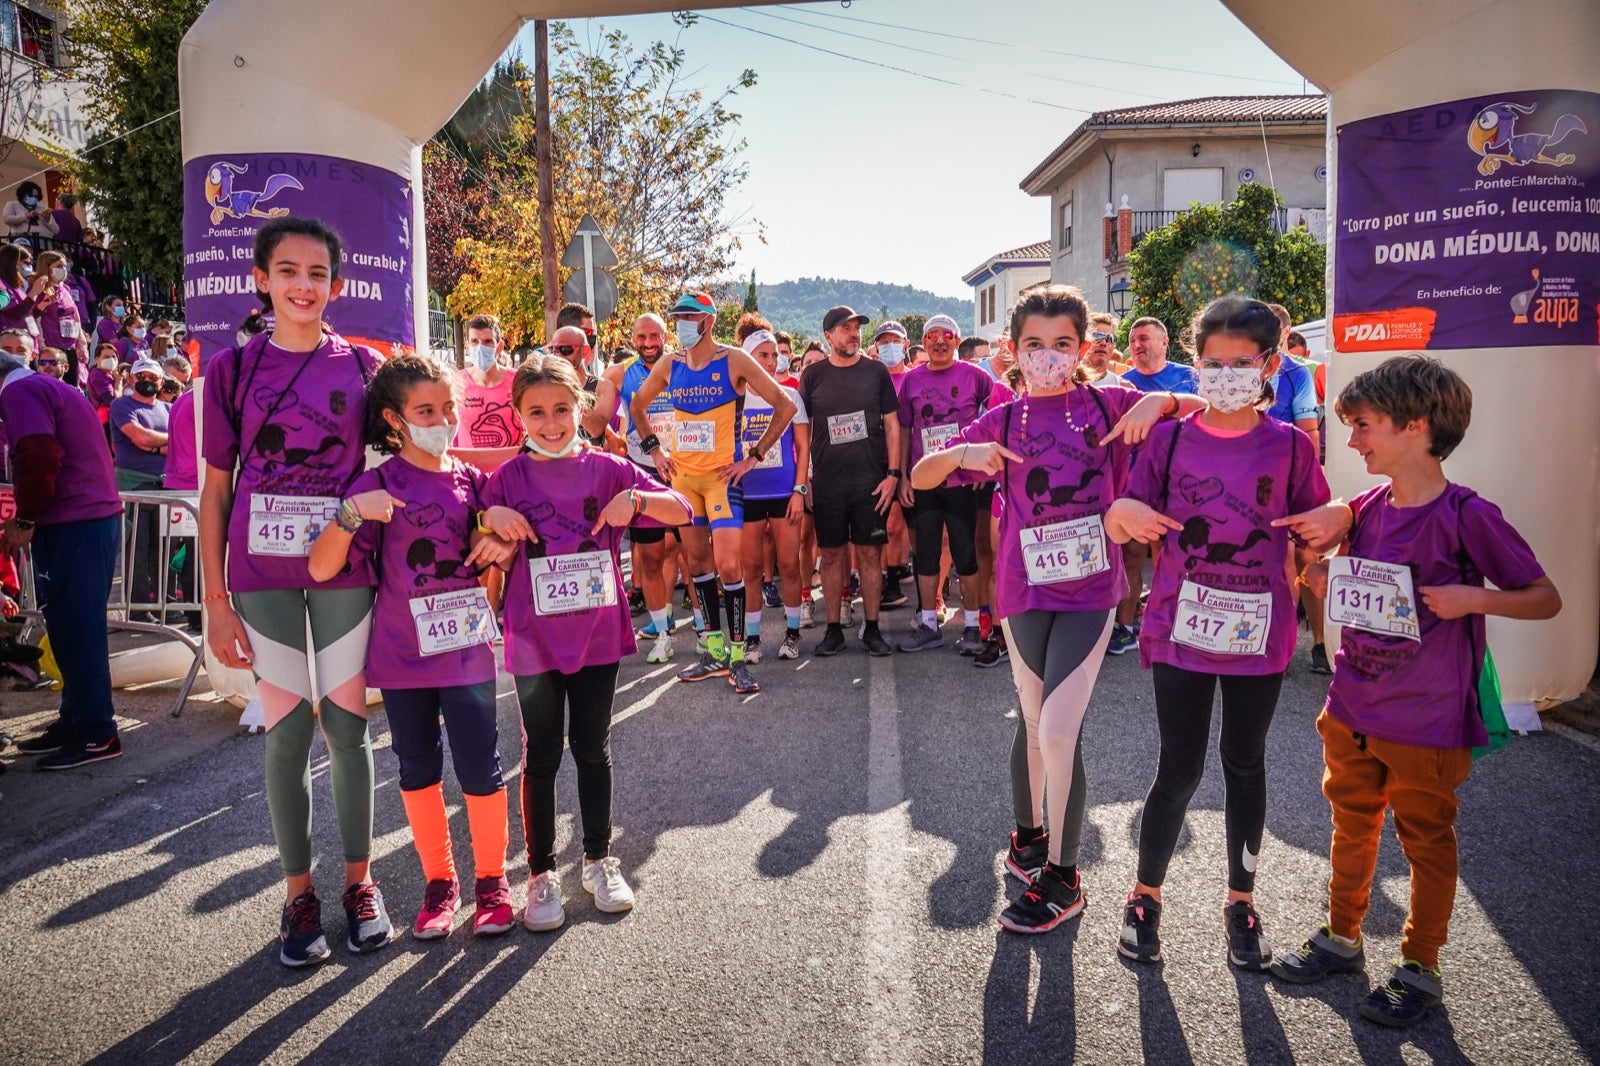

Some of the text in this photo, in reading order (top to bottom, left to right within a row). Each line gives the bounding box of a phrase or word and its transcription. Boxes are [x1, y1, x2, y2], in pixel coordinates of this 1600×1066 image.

[1384, 212, 1410, 231] por
[1414, 209, 1437, 223] un
[1443, 200, 1505, 221] sueño,
[1512, 197, 1581, 213] leucemia
[196, 246, 229, 262] sueño,
[232, 245, 254, 260] leu
[1375, 229, 1600, 265] DONA MÉDULA, DONA
[197, 272, 257, 297] MÉDULA
[1417, 284, 1502, 299] En beneficio de:
[1533, 298, 1579, 328] aupa
[1344, 323, 1386, 342] PDA
[672, 384, 724, 400] agustinos
[679, 434, 698, 443] 1099
[832, 426, 852, 436] 1211
[264, 497, 275, 512] V
[258, 524, 295, 541] 415
[1033, 528, 1043, 543] V
[1045, 529, 1078, 541] CARRERA
[547, 559, 557, 572] V
[558, 562, 590, 571] CARRERA
[1035, 551, 1069, 569] 416
[1350, 559, 1362, 576] V
[547, 581, 580, 599] 243
[1197, 586, 1209, 603] V
[424, 597, 435, 612] V
[436, 599, 467, 610] CARRERA
[1207, 599, 1245, 610] CARRERA
[1337, 588, 1384, 613] 1311
[428, 619, 458, 638] 418
[1186, 614, 1225, 637] 417
